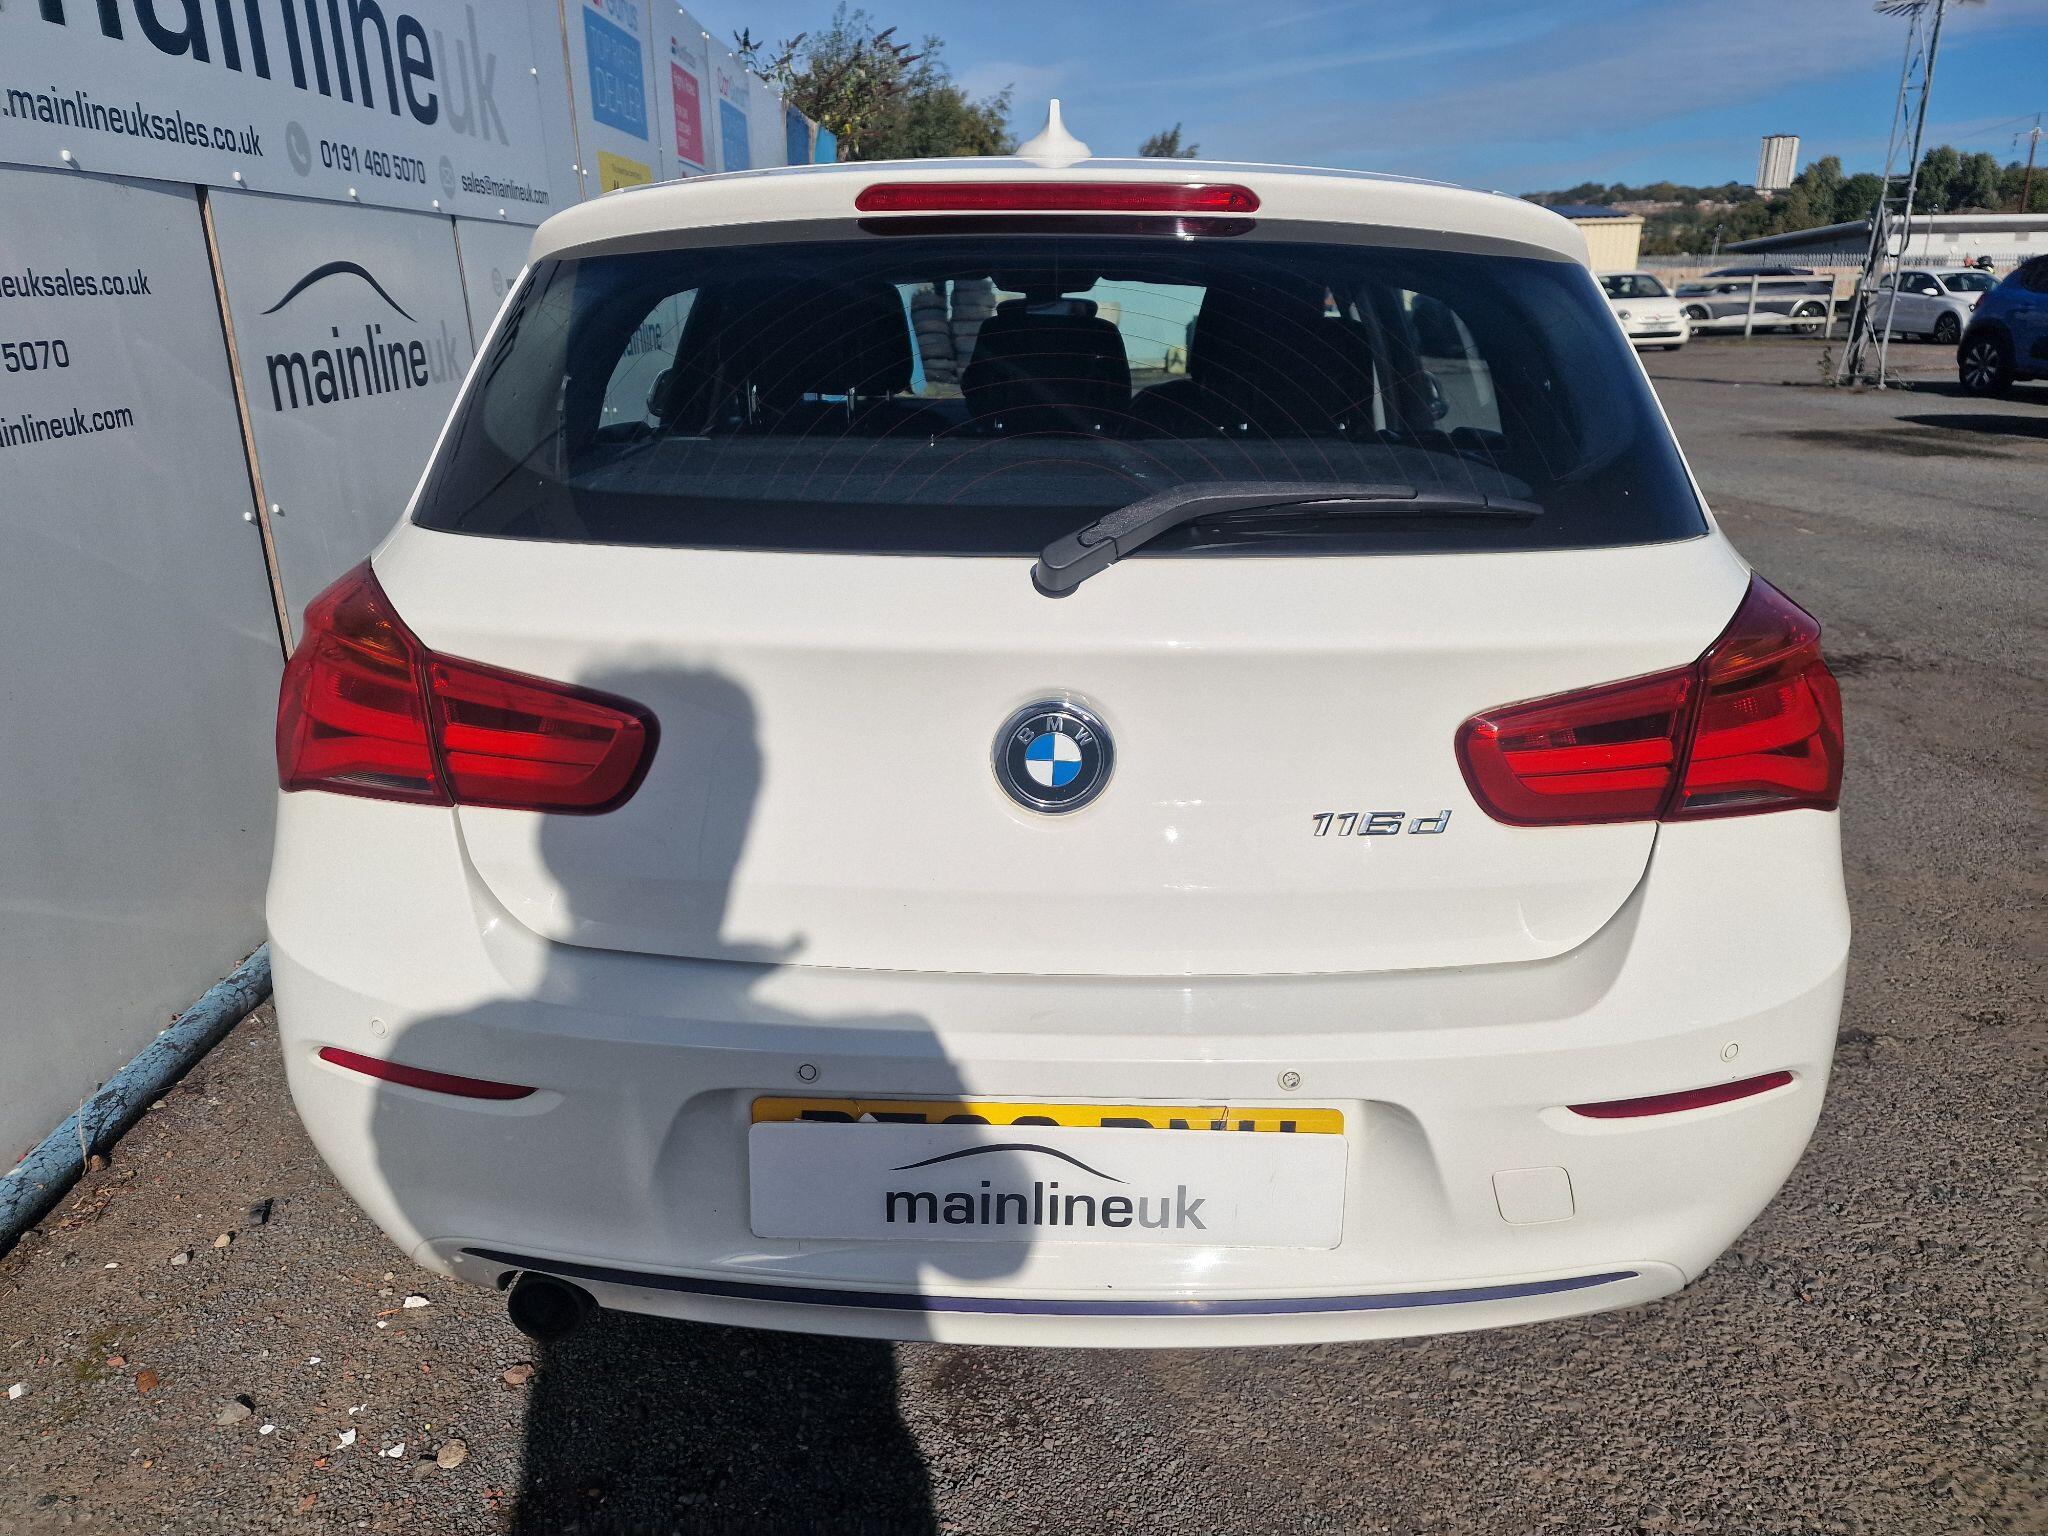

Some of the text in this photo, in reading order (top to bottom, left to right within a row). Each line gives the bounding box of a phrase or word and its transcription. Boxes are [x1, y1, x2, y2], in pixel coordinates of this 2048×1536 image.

[320, 140, 426, 184] 0191 460 5070
[461, 170, 550, 205] sales@mainlineuk.com
[0, 267, 151, 298] euksales.co.uk
[1, 339, 70, 372] 5070
[265, 319, 464, 412] mainlineuk
[0, 407, 134, 447] inlineuk.com
[1016, 715, 1093, 748] BMW
[1312, 809, 1452, 837] 116d
[886, 1180, 1207, 1230] mainlineuk
